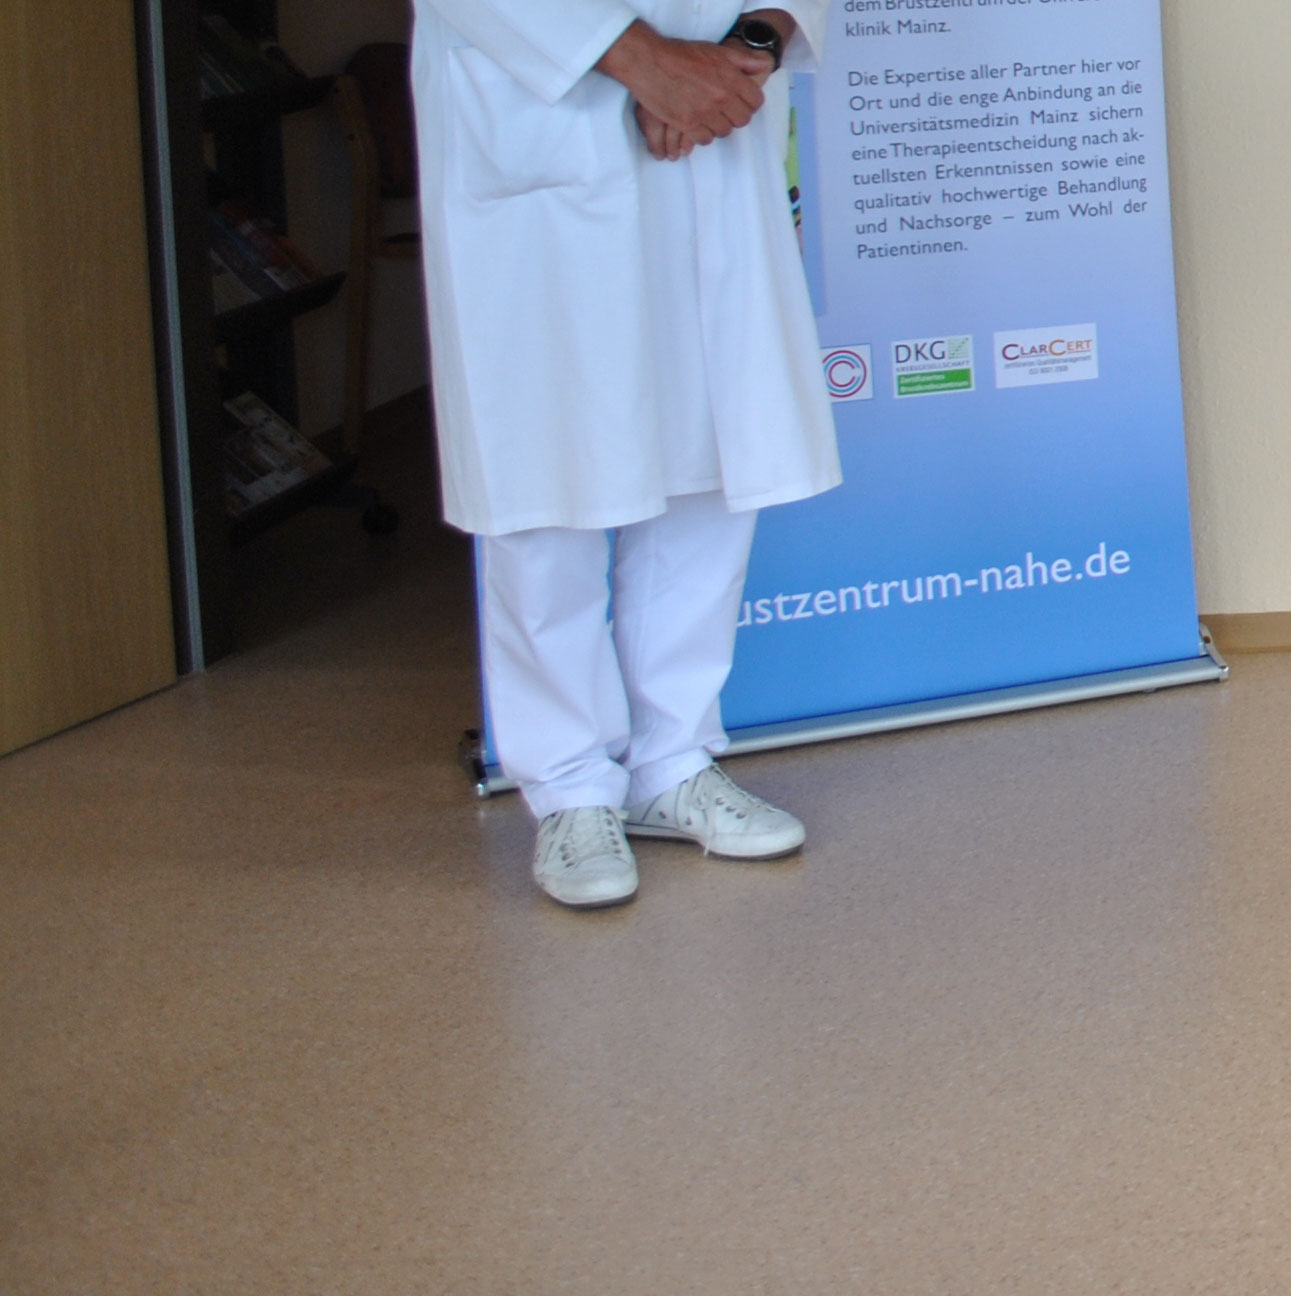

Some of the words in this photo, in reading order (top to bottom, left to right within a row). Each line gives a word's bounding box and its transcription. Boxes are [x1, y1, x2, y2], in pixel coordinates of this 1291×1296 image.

[845, 21, 892, 37] klinik
[897, 19, 952, 35] Mainz.
[849, 71, 879, 88] Die
[885, 66, 966, 87] Expertise
[970, 63, 1008, 80] aller
[1013, 59, 1076, 78] Partner
[1081, 57, 1113, 74] hier
[1118, 58, 1141, 72] vor
[850, 95, 883, 112] Ort
[889, 92, 921, 109] und
[927, 89, 954, 107] die
[959, 89, 999, 107] enge
[1004, 83, 1092, 104] Anbindung
[1098, 83, 1116, 97] an
[1122, 80, 1143, 96] die
[851, 113, 1019, 136] Universitätsmedizin
[1031, 108, 1079, 125] Mainz
[1089, 105, 1143, 121] sichern
[851, 143, 887, 161] eine
[890, 133, 1078, 160] Therapieentscheidung
[1082, 129, 1119, 147] nach
[1123, 128, 1145, 143] ak-
[853, 167, 927, 186] tuellsten
[935, 158, 1054, 179] Erkenntnissen
[1062, 154, 1109, 172] sowie
[1116, 152, 1146, 167] eine
[854, 192, 932, 213] qualitativ
[942, 183, 1048, 205] hochwertige
[1058, 175, 1148, 197] Behandlung
[856, 217, 888, 235] und
[900, 210, 993, 233] Nachsorge
[1026, 207, 1060, 223] zum
[1070, 202, 1114, 218] Wohl
[1124, 199, 1148, 215] der
[857, 238, 968, 260] Patientinnen.
[895, 340, 946, 363] DKG
[737, 542, 1131, 627] ustzentrum-nahe.de
